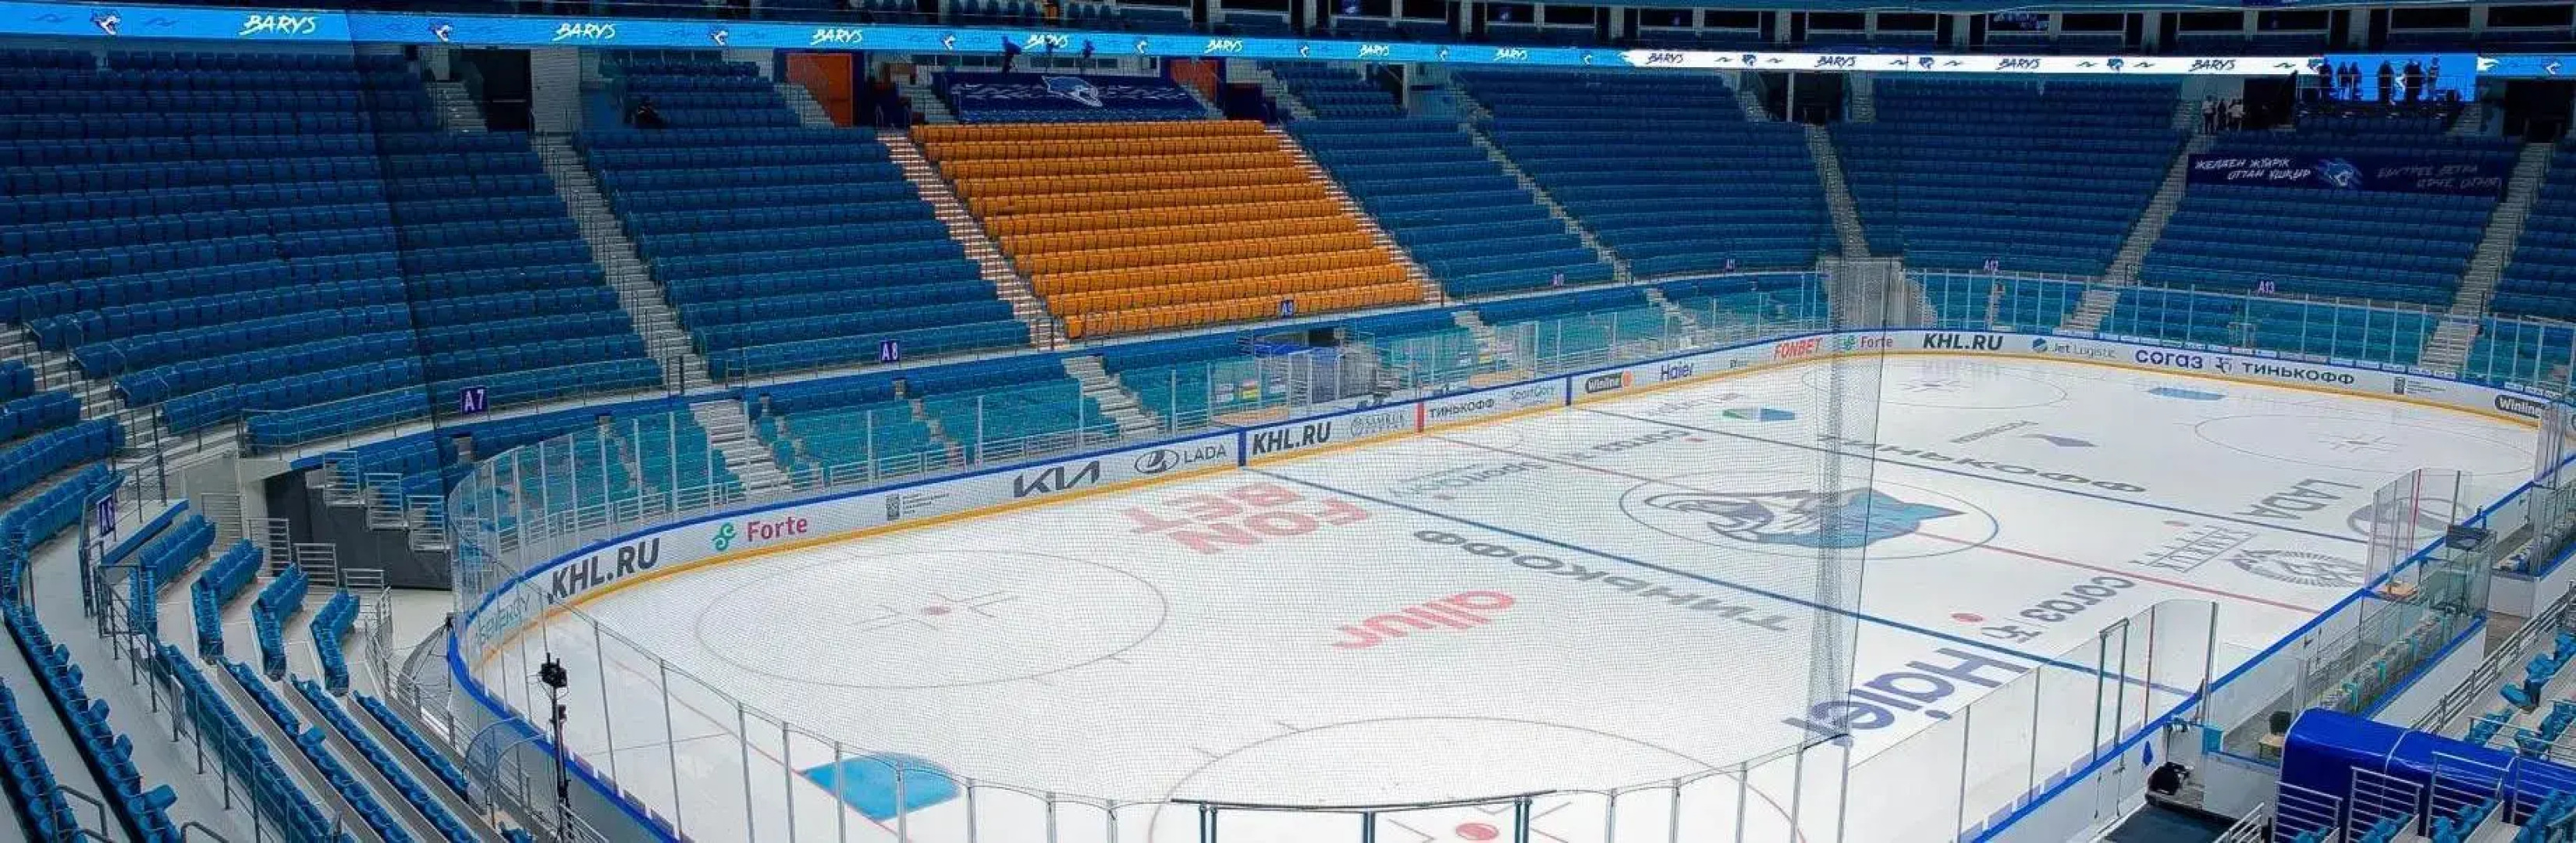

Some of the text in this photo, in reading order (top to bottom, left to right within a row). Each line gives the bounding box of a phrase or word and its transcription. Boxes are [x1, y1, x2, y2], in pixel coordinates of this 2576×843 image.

[240, 15, 319, 35] BARYS
[553, 23, 616, 41] BARYS
[811, 29, 862, 44] BARYS
[1204, 40, 1242, 54] BARYS
[1646, 53, 1683, 65] BARYS
[1814, 56, 1856, 67] BARYS
[1995, 59, 2041, 70] BARYS
[2189, 59, 2236, 72] BARYS
[882, 342, 898, 361] A8
[1774, 337, 1822, 360] FONBET
[1860, 336, 1893, 349] Forte
[1923, 333, 2003, 350] KHL.RU
[1661, 362, 1694, 381] Haier
[2242, 362, 2354, 384] ТИНЬКОФФ
[465, 389, 484, 411] A7
[1429, 398, 1494, 418] ТИНЬКОФФ
[1252, 422, 1332, 455] KHL.RU
[1183, 444, 1228, 464] LADA
[1121, 481, 1305, 534] BET
[2233, 478, 2363, 521] LADA
[747, 516, 808, 542] Forte
[1169, 496, 1371, 555] FON
[547, 537, 660, 604] KHL.RU
[1782, 647, 2031, 746] Haier
